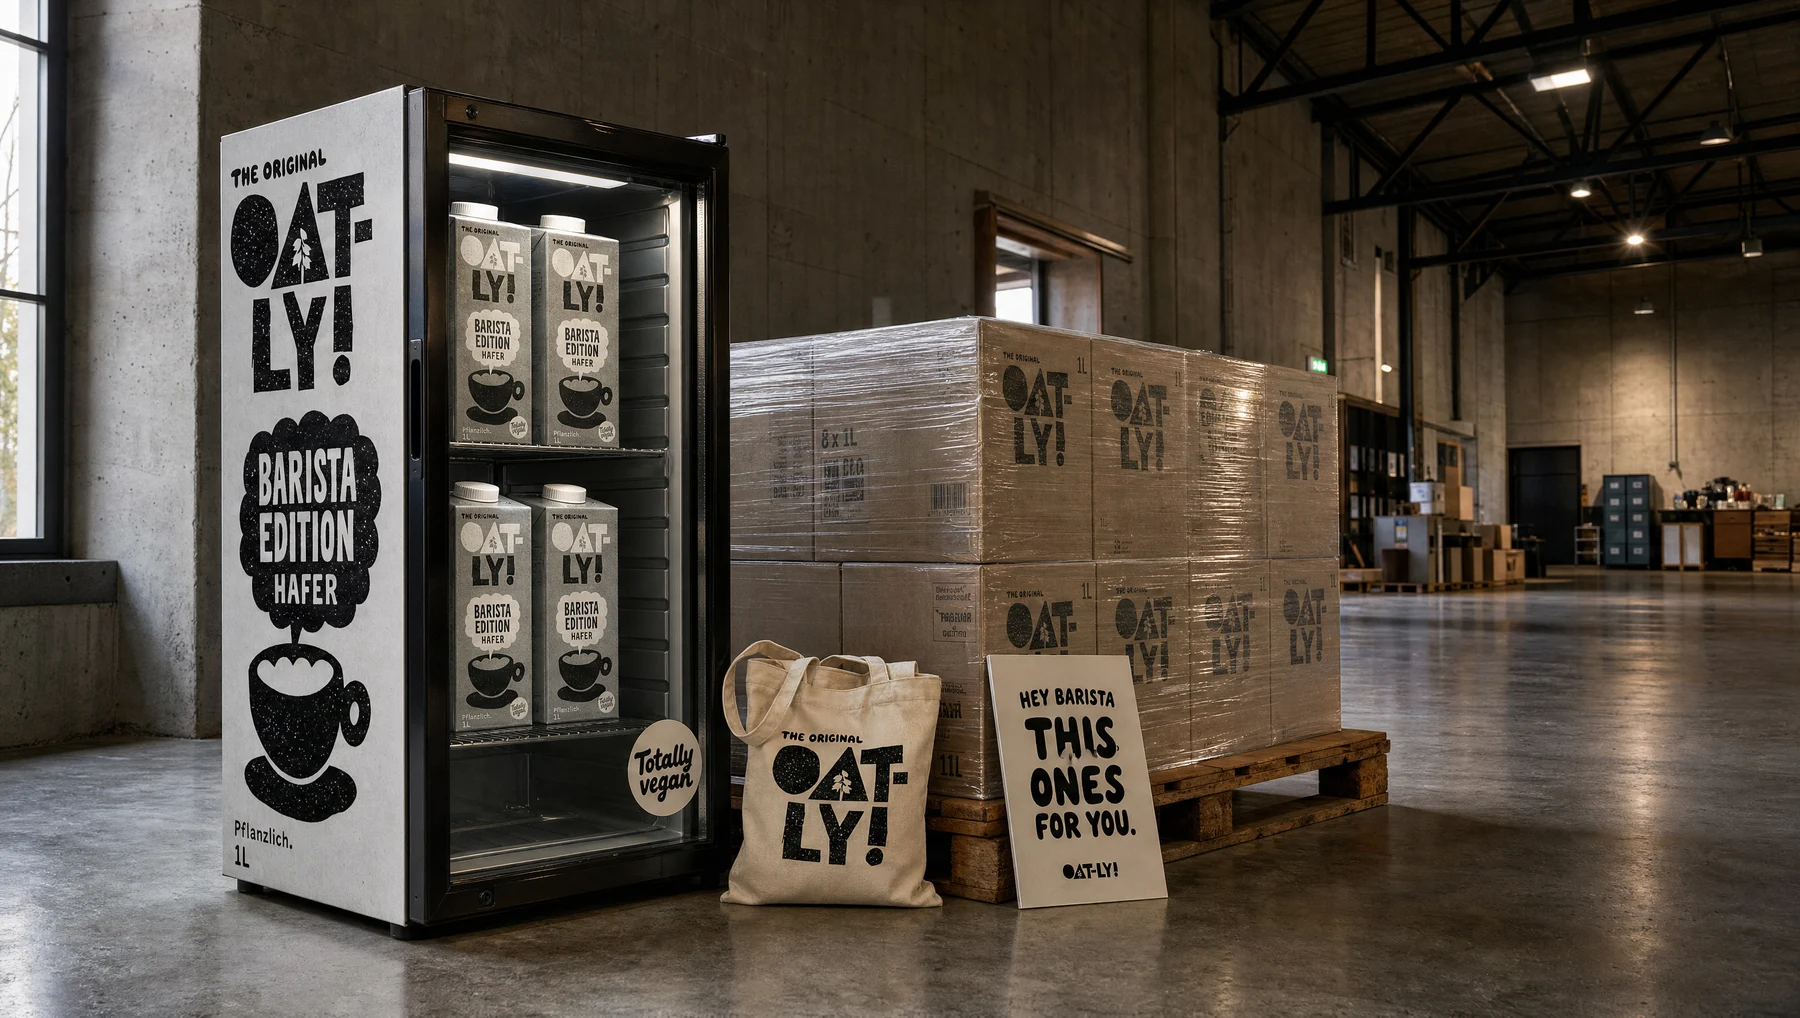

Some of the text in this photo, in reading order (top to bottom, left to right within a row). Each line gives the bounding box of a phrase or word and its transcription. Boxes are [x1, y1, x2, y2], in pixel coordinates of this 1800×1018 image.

[231, 148, 327, 189] THE ORIGINAL
[231, 172, 373, 290] OAT-
[461, 225, 500, 236] THE ORIGINAL
[553, 238, 589, 249] THE ORIGINAL
[460, 235, 524, 273] OAT-
[552, 247, 612, 283] OAT-
[472, 269, 516, 304] LY!
[562, 280, 604, 313] LY!
[252, 285, 354, 394] LY!
[474, 319, 512, 336] BARISTA
[475, 335, 510, 350] EDITION
[564, 328, 600, 343] BARISTA
[482, 351, 505, 361] HAFER
[566, 342, 599, 358] EDITION
[572, 358, 594, 368] HAFER
[1003, 352, 1041, 364] THE ORIGINAL
[1077, 356, 1088, 374] 1L
[1111, 367, 1121, 376] THE
[1174, 371, 1183, 388] 1L
[1002, 364, 1073, 419] OAT-
[1110, 379, 1170, 428] OAT-
[821, 428, 829, 449] 8
[832, 433, 839, 448] x
[843, 427, 858, 447] 1L
[1014, 417, 1066, 467] LY!
[1120, 426, 1165, 472] LY!
[259, 447, 357, 506] BARISTA
[1286, 441, 1320, 481] LY!
[259, 510, 354, 563] EDITION
[460, 521, 524, 554] OAT-
[552, 521, 611, 553] OAT-
[472, 555, 515, 586] LY!
[562, 554, 603, 584] LY!
[275, 573, 338, 605] HAFER
[1006, 590, 1044, 599] THE ORIGINAL
[1081, 582, 1092, 600] 1L
[474, 603, 512, 619] BARISTA
[564, 601, 599, 616] BARISTA
[565, 616, 598, 631] EDITION
[475, 619, 510, 634] EDITION
[481, 635, 505, 644] HAFER
[571, 631, 593, 641] HAFER
[1006, 600, 1077, 650] OAT-
[1211, 633, 1250, 677] LY!
[1289, 626, 1323, 666] LY!
[1125, 640, 1169, 686] LY!
[1019, 688, 1115, 709] HEY BARISTA
[781, 730, 864, 744] THE ORIGINAL
[634, 743, 694, 775] Totally
[772, 745, 909, 803] OAT-
[640, 772, 694, 803] vegan
[1030, 764, 1125, 808] ONES
[235, 820, 293, 849] Pflanzlich.
[782, 801, 889, 867] LY!
[1035, 809, 1137, 840] FOR YOU.
[235, 845, 250, 868] 1L
[1062, 862, 1119, 880] OAT-LY!
